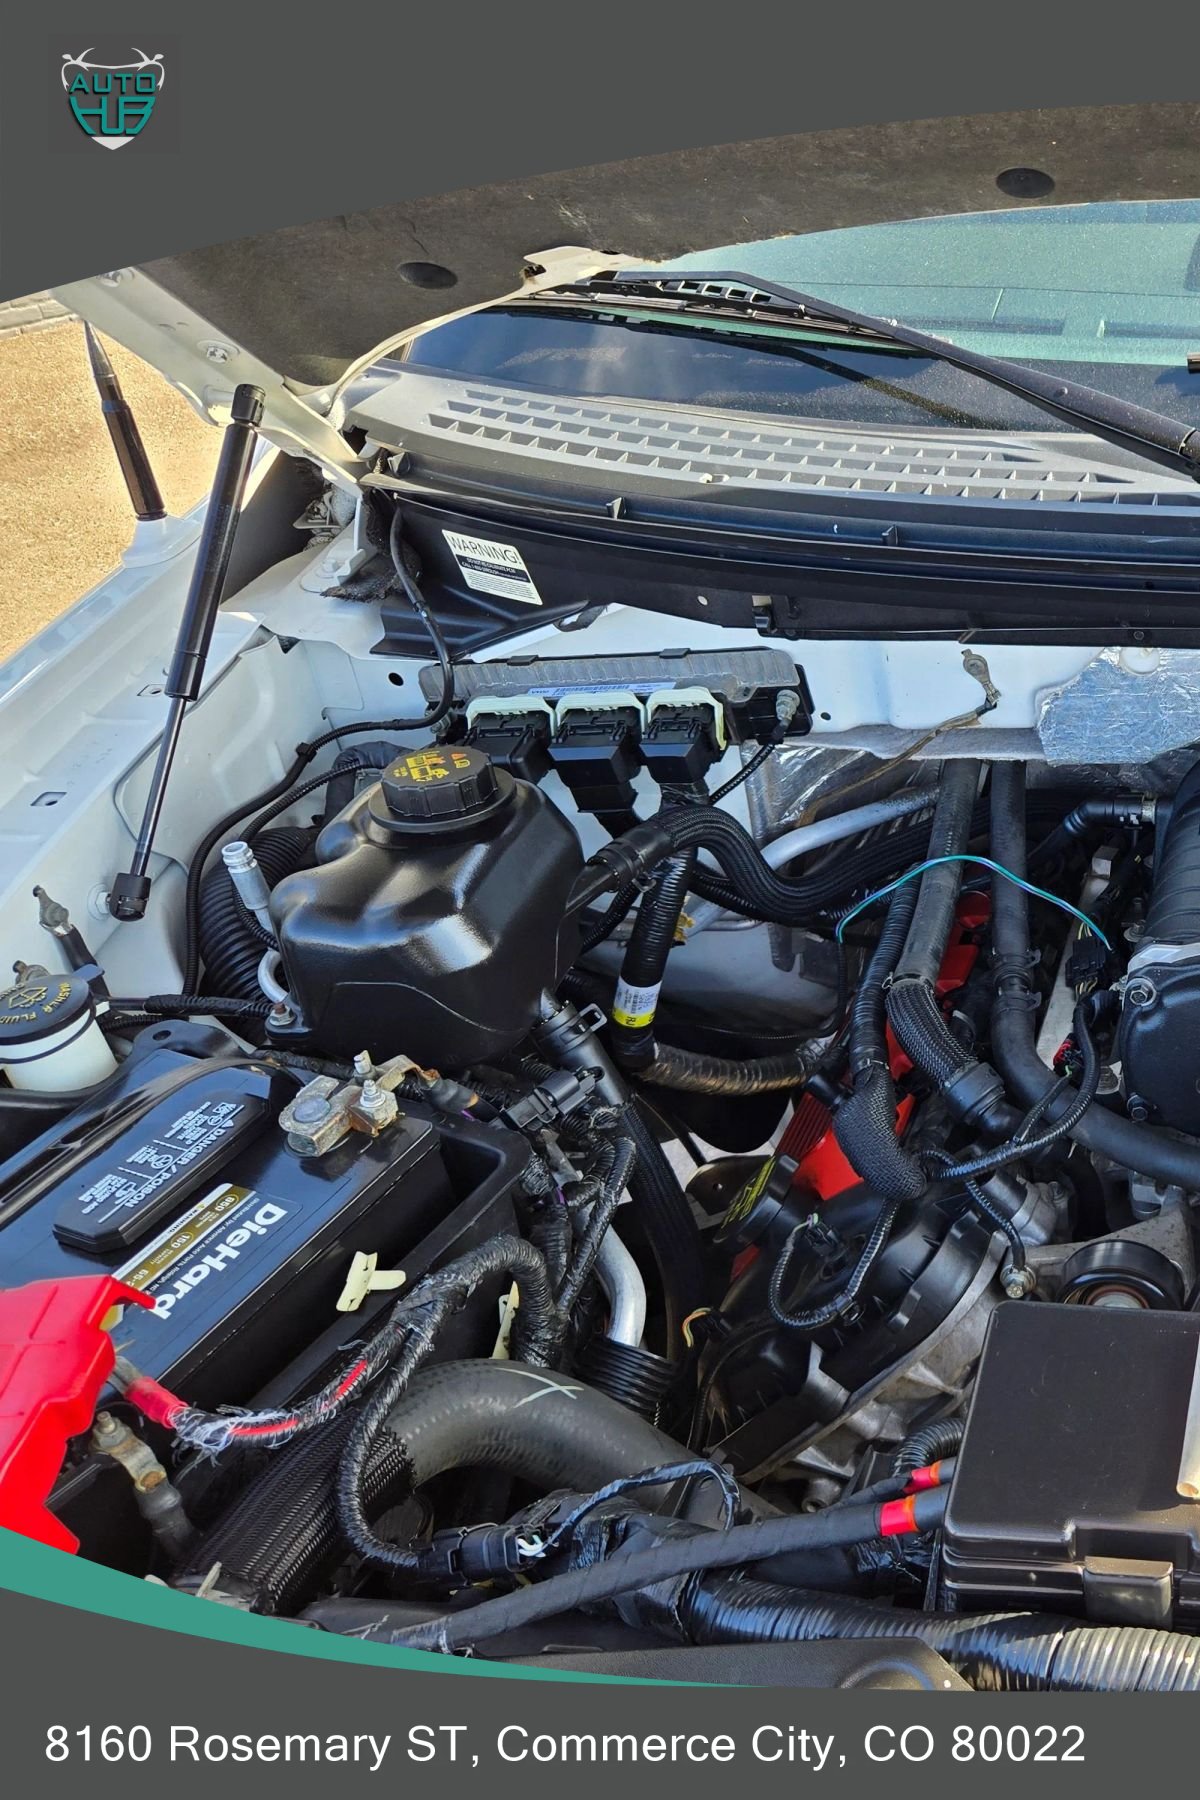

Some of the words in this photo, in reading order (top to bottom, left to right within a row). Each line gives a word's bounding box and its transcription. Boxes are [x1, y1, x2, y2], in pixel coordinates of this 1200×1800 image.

[446, 534, 522, 564] WARNING!
[175, 1127, 226, 1166] DANGER
[123, 1171, 172, 1208] POISON
[168, 1232, 191, 1249] 150
[143, 1201, 289, 1320] DieHard
